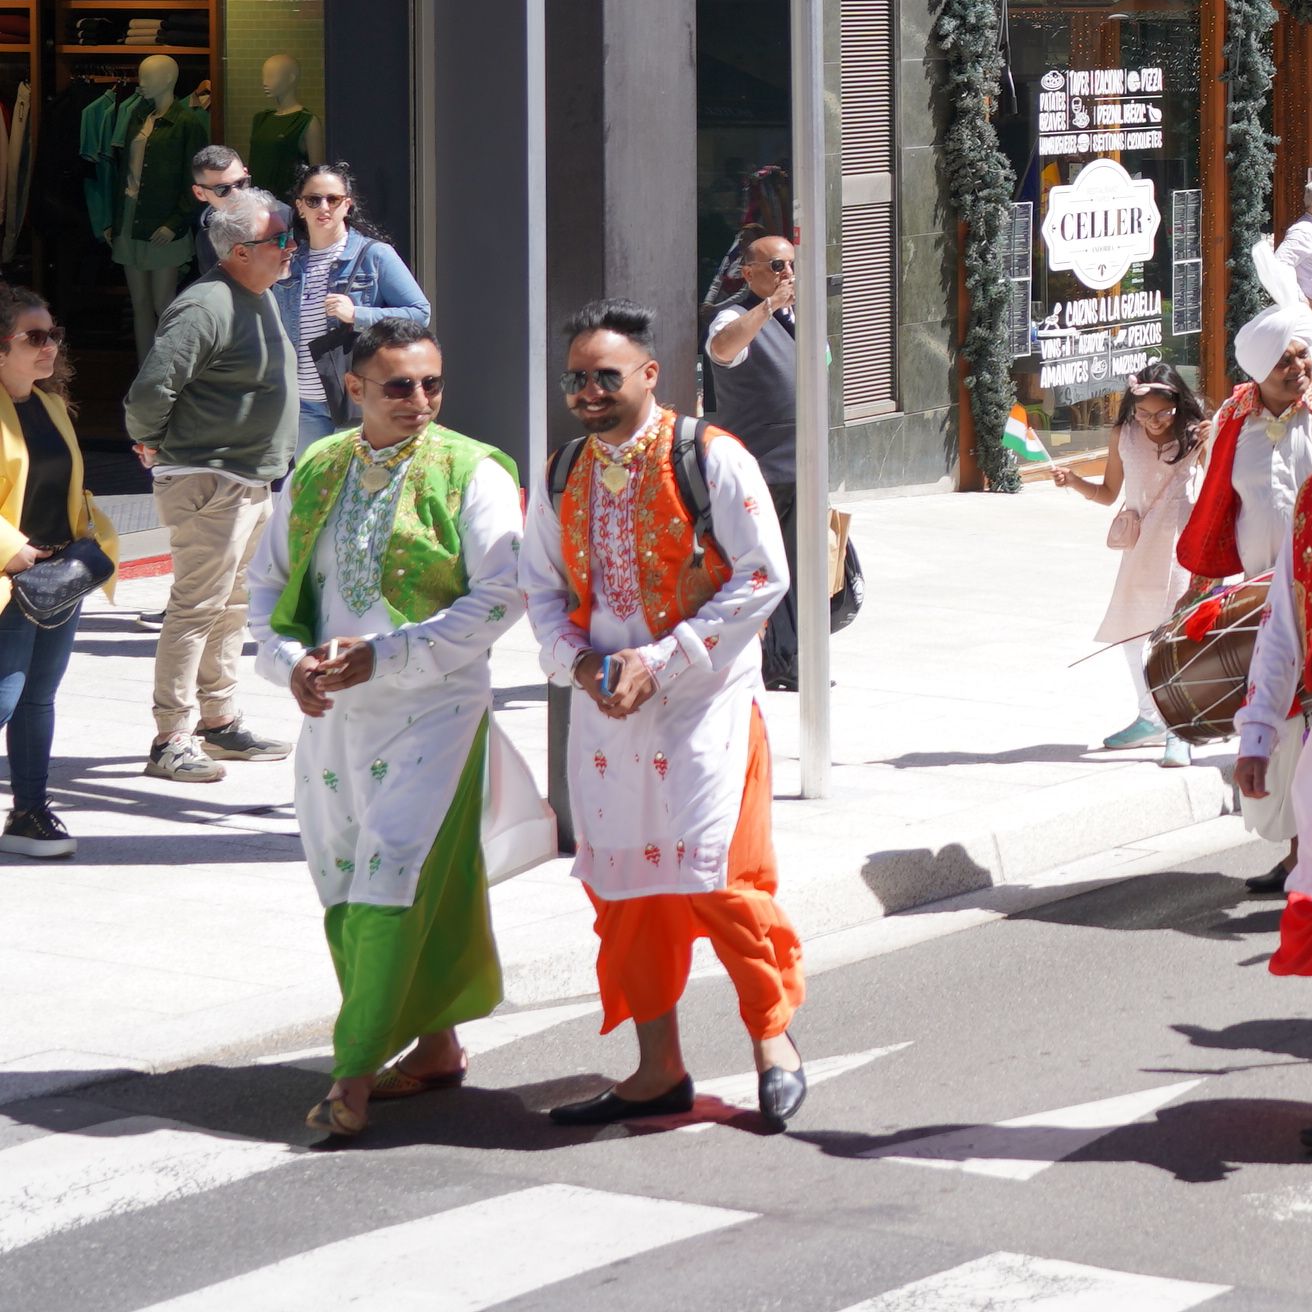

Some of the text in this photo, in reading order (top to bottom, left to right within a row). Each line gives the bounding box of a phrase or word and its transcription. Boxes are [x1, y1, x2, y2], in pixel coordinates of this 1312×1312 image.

[1060, 207, 1143, 242] CELLER
[1065, 289, 1162, 327] CARNS A LA GRAELLA
[1041, 337, 1062, 360] VINS
[1128, 322, 1162, 347] PEIXOS
[1040, 359, 1089, 388] AMANIDES
